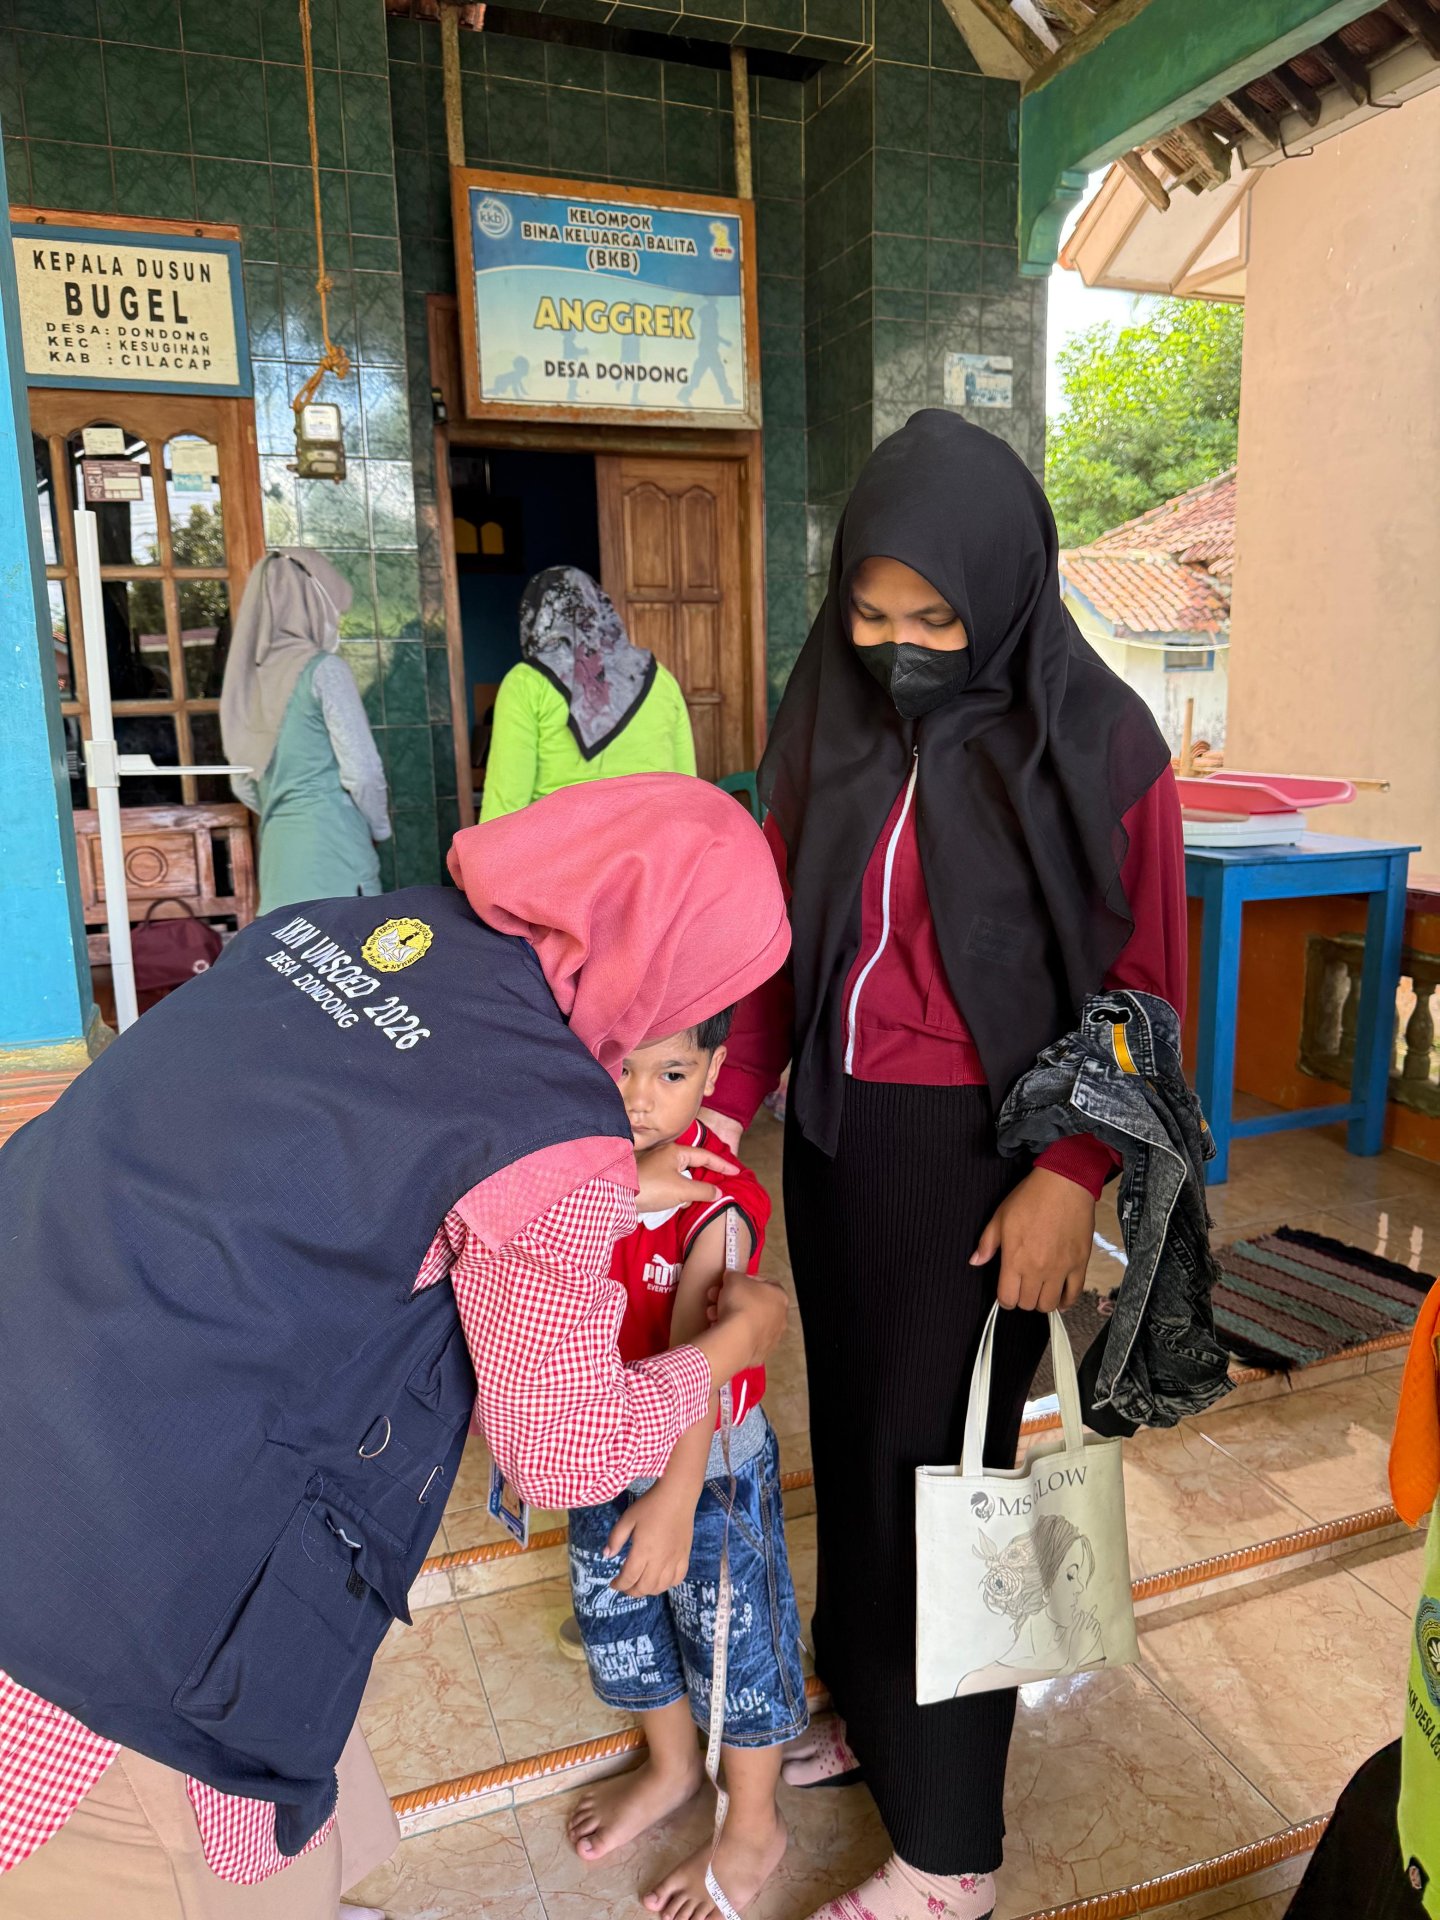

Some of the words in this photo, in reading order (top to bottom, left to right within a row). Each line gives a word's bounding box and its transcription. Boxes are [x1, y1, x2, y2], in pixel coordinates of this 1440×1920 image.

[569, 208, 652, 230] KELOMPOK
[523, 223, 559, 241] BINA
[565, 228, 641, 248] KELUARGA
[647, 234, 696, 254] BALITA
[33, 250, 123, 277] KEPALA
[137, 258, 212, 283] DUSUN
[588, 249, 639, 272] (BKB)
[64, 281, 189, 325] BUGEL
[534, 296, 694, 339] ANGGREK
[118, 326, 209, 342] DONDONG
[47, 336, 89, 348] KEC
[119, 340, 211, 356] KESUGIHAN
[49, 352, 91, 364] KAB
[121, 354, 212, 371] CILACAP
[545, 360, 589, 379] DESA
[596, 363, 689, 383] DONDONG
[265, 951, 302, 977] DESA
[292, 973, 359, 1028] DONDONG
[301, 936, 381, 998] UNSOED
[363, 996, 431, 1049] 2026
[647, 1282, 673, 1294] EVERY
[596, 1599, 648, 1618] DIVISION
[640, 1671, 662, 1685] ONE
[1415, 1702, 1436, 1741] DESA
